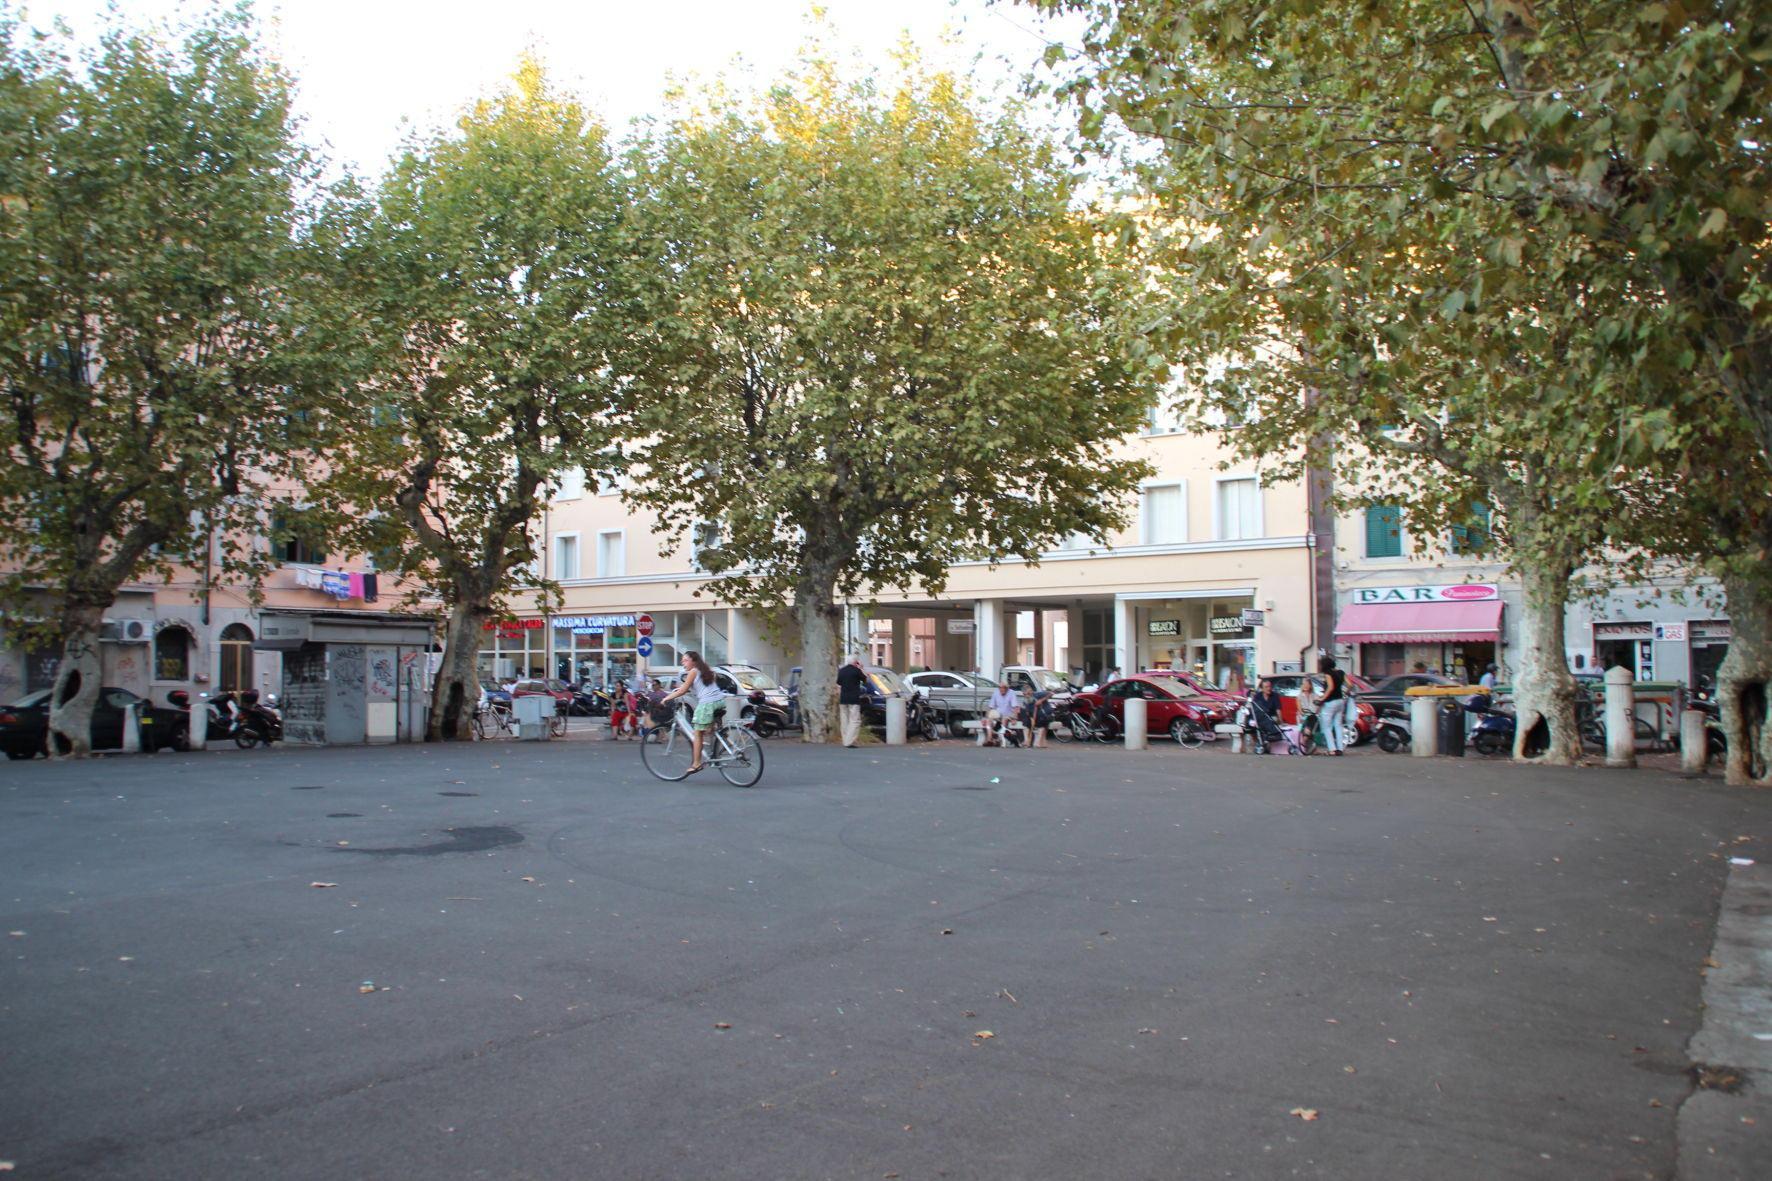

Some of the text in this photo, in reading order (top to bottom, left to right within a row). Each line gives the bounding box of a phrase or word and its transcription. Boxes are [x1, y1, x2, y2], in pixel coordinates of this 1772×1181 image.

[1360, 587, 1435, 602] BAR
[552, 616, 586, 628] MASSIMA
[587, 615, 635, 627] CURVATURA
[638, 621, 653, 630] STOP
